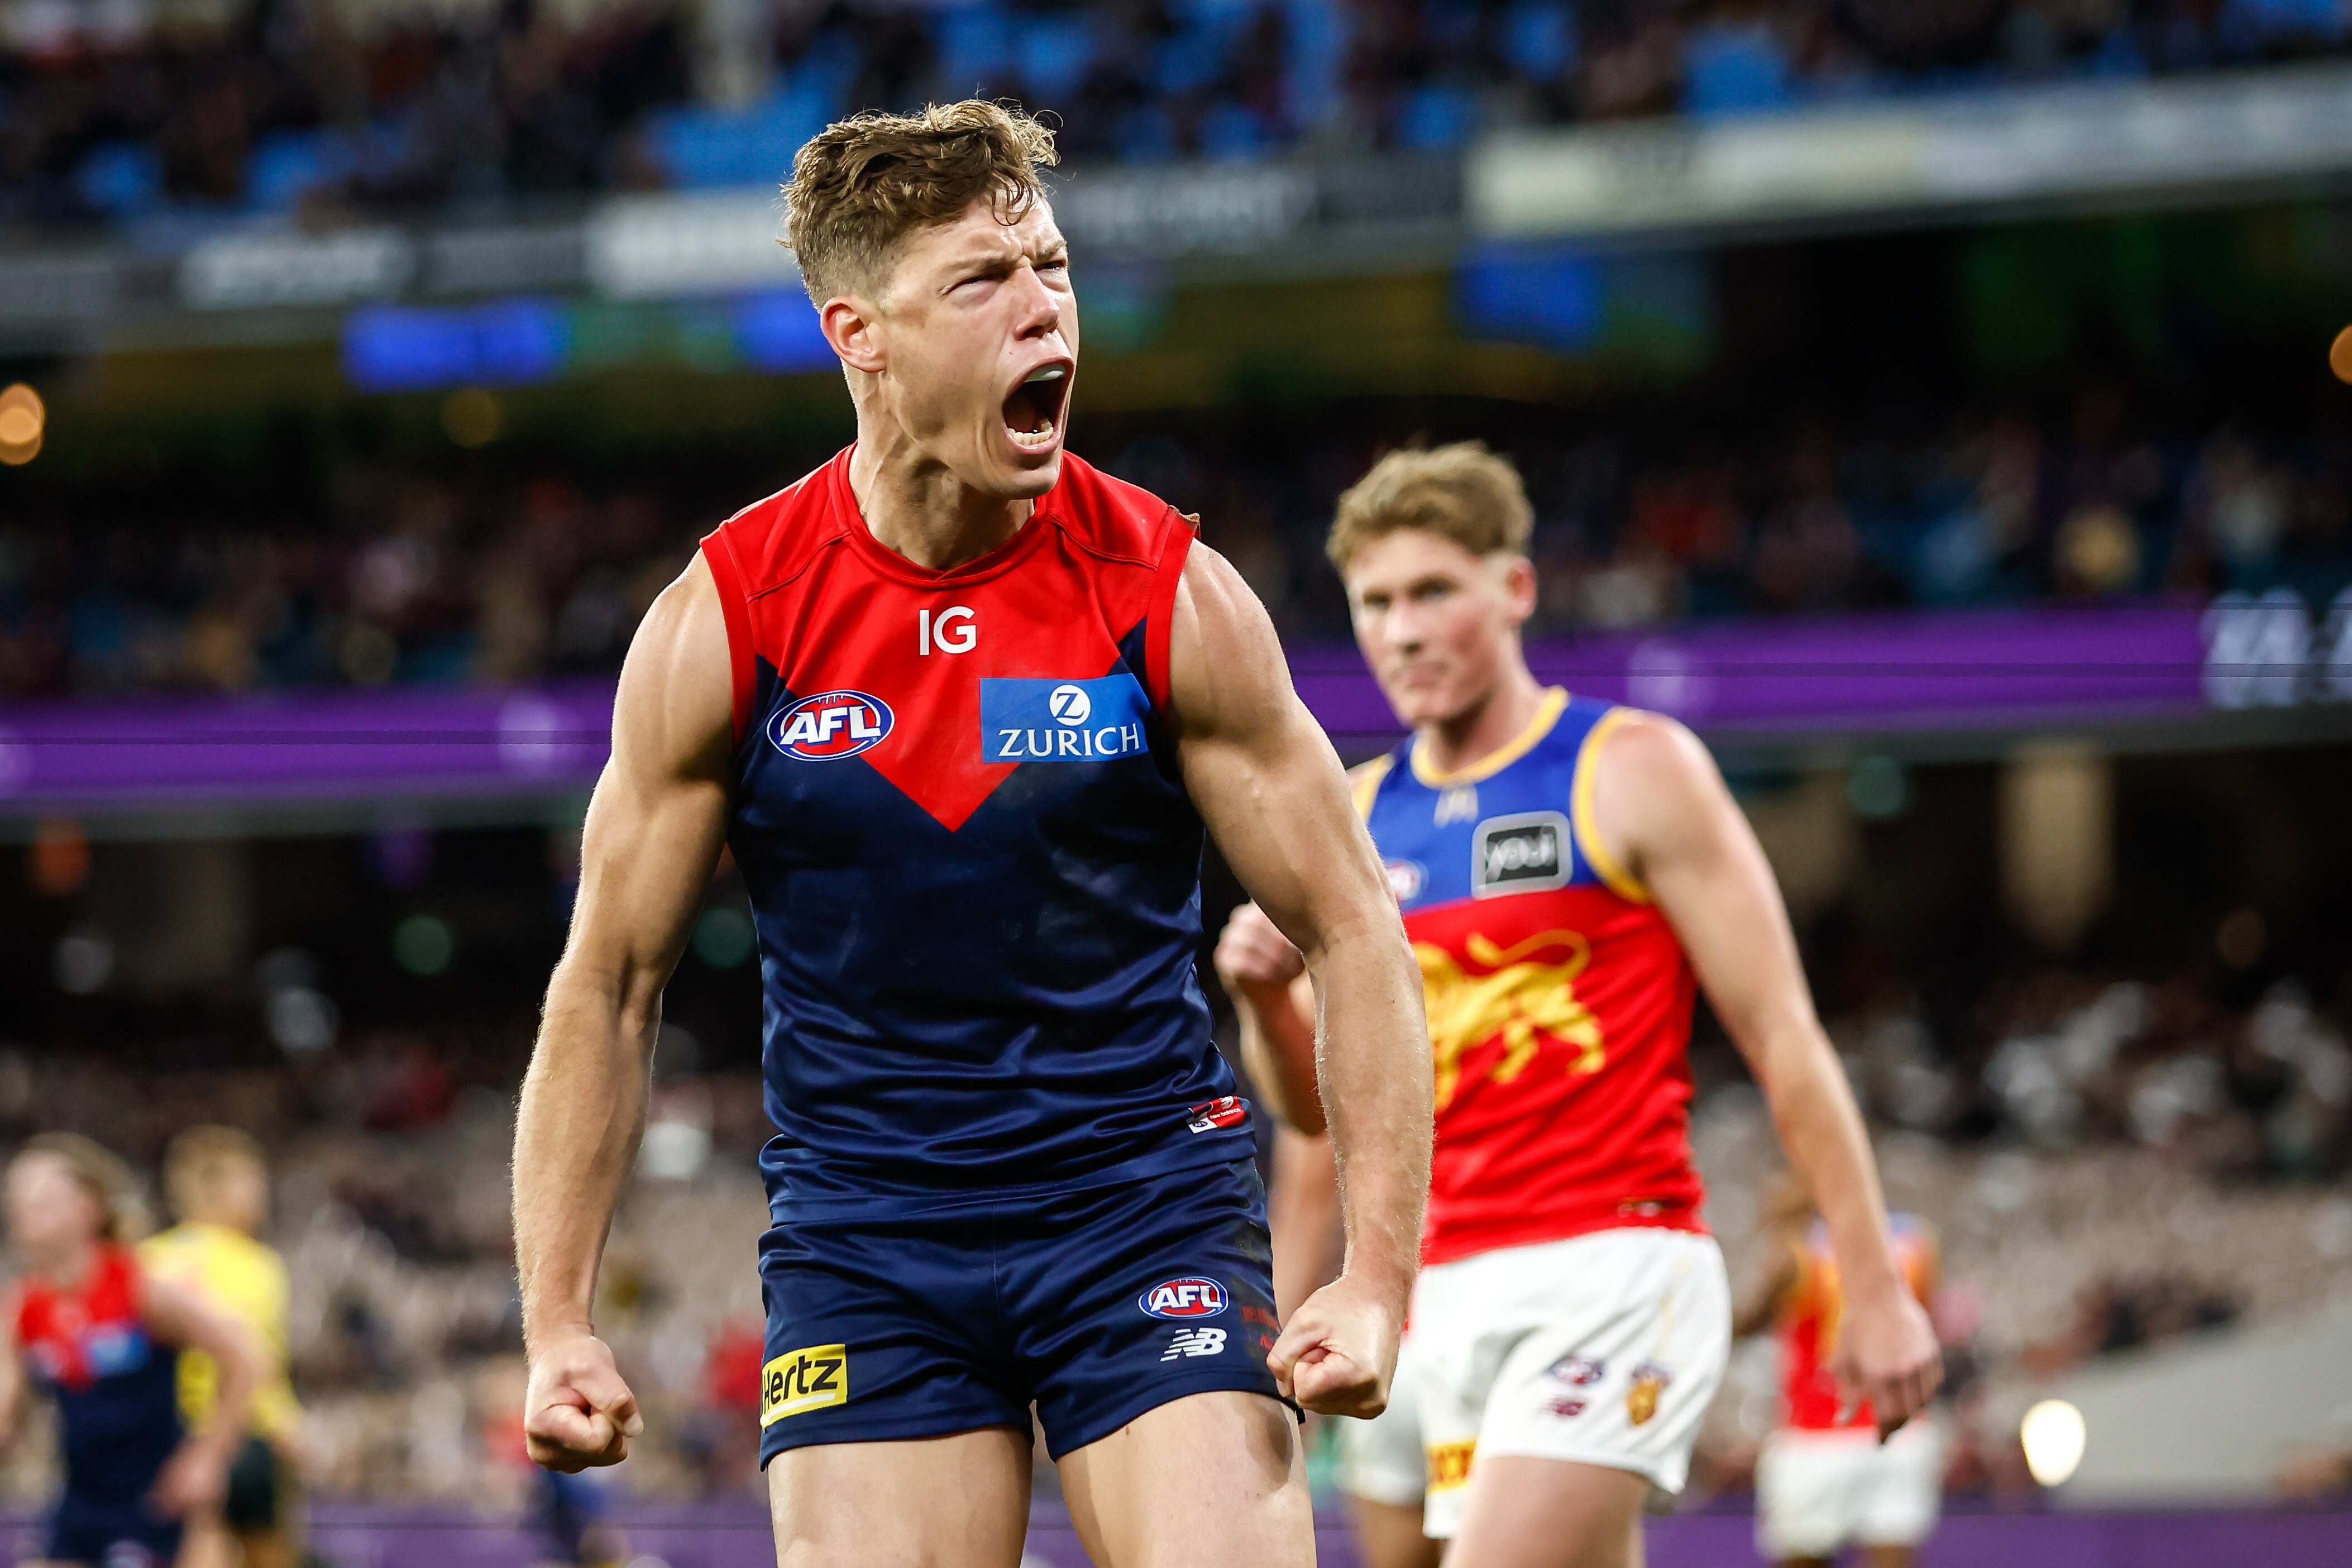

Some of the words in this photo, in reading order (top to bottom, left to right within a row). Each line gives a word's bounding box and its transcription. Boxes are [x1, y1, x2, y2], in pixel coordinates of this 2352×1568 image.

[919, 606, 977, 656] IG
[1056, 693, 1085, 719] Z
[780, 705, 881, 745] AFL
[998, 723, 1140, 757] ZURICH
[1150, 1285, 1223, 1312] AFL
[1160, 1327, 1227, 1362] NB
[764, 1355, 842, 1414] Hertz
